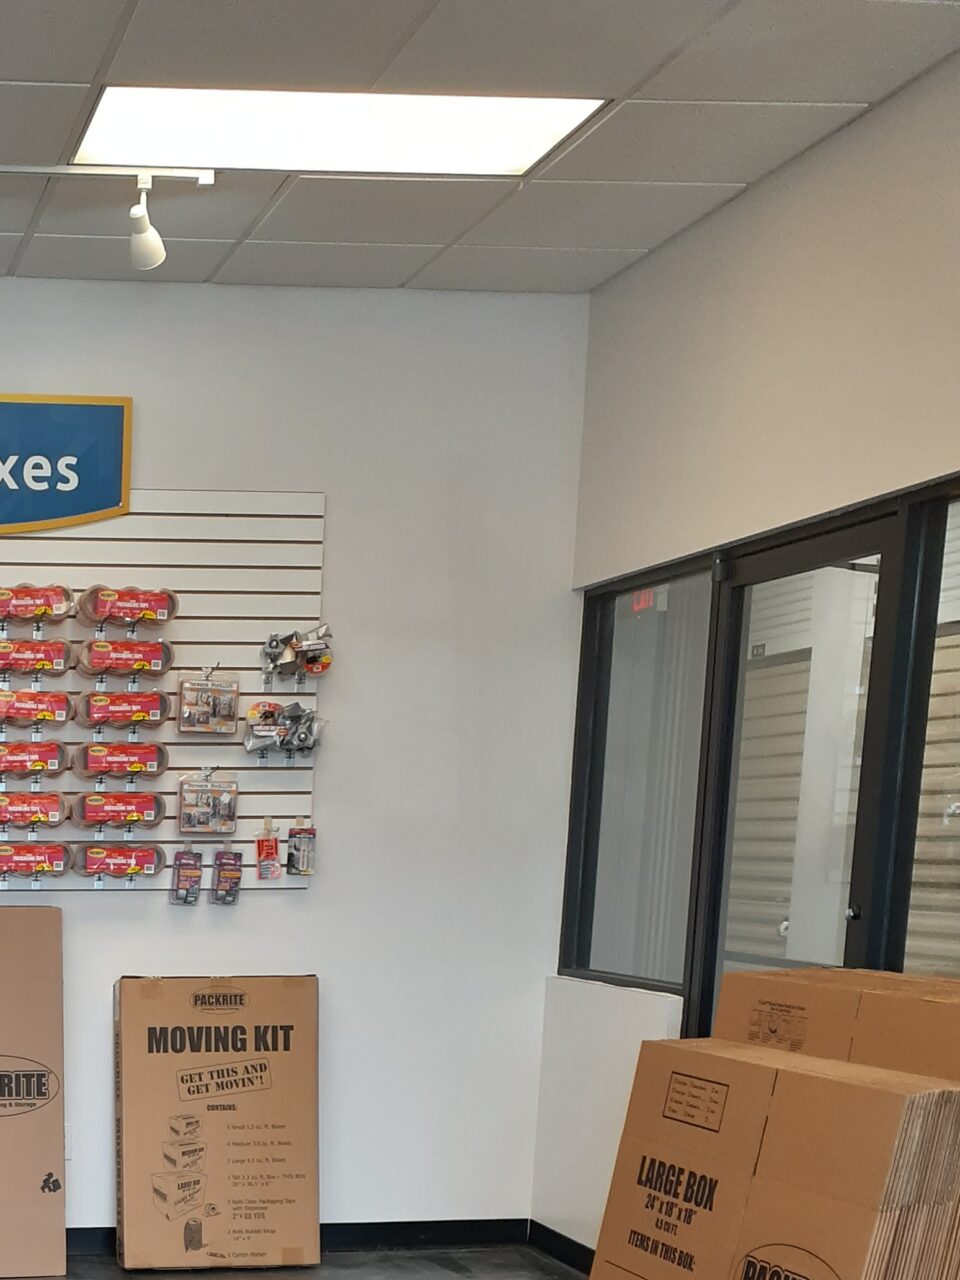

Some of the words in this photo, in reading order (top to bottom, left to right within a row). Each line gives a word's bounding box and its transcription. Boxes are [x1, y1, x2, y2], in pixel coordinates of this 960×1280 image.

[194, 994, 245, 1006] PACKRITE
[147, 1025, 248, 1054] MOVING
[254, 1024, 294, 1052] KIT
[180, 1071, 204, 1085] GET
[208, 1067, 238, 1081] THIS
[242, 1062, 268, 1076] AND
[187, 1083, 211, 1096] GET
[14, 1101, 37, 1109] Storage
[207, 1104, 238, 1112] CONTAINS:
[637, 1155, 685, 1200] LARGE
[683, 1170, 719, 1212] BOX
[645, 1193, 660, 1211] 24"
[664, 1201, 679, 1218] 18"
[683, 1208, 698, 1225] 18"
[628, 1229, 651, 1253] ITEMS
[649, 1238, 661, 1257] IN
[659, 1242, 678, 1264] THIS
[676, 1249, 696, 1273] BOX:
